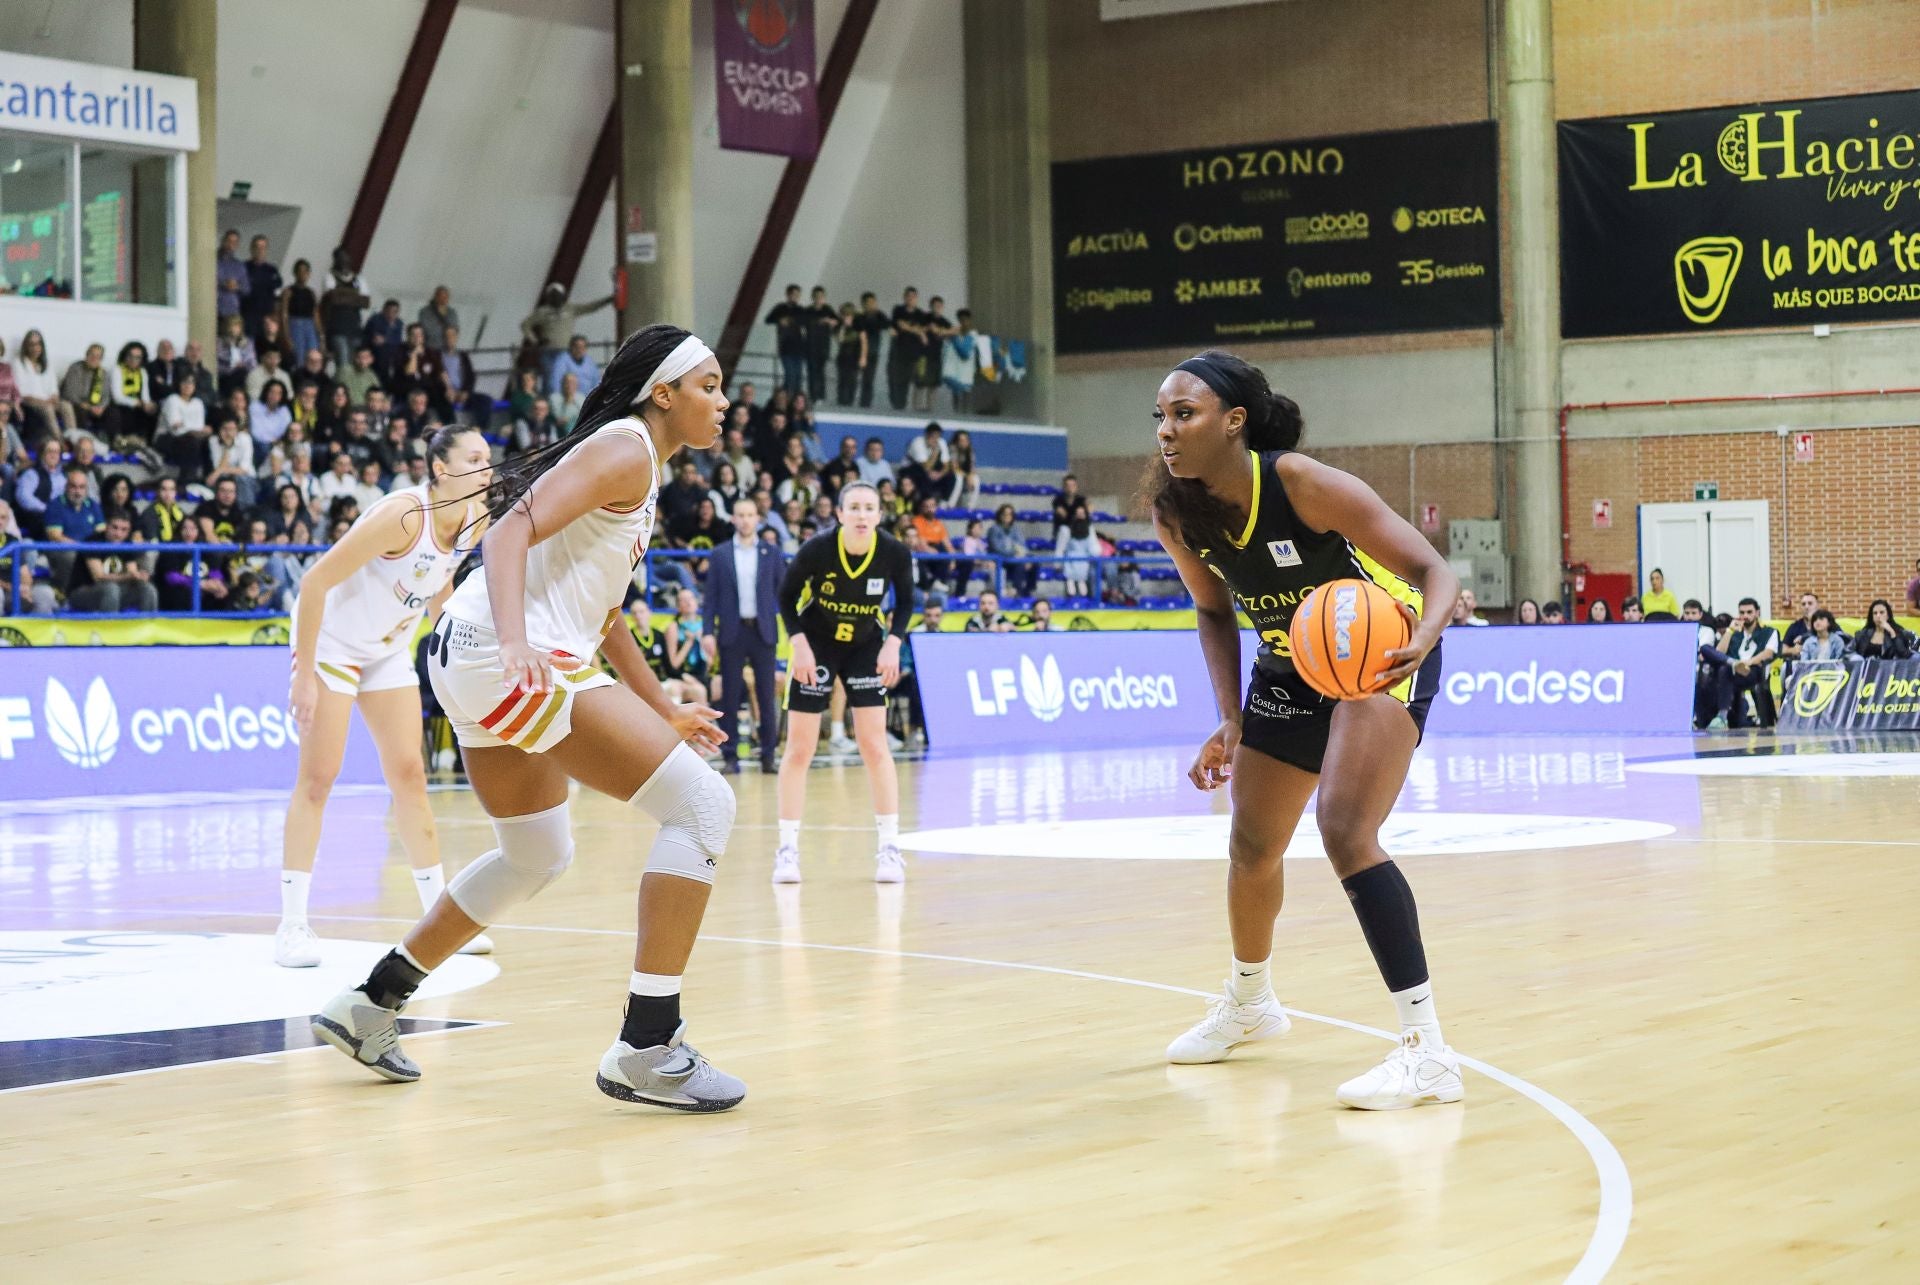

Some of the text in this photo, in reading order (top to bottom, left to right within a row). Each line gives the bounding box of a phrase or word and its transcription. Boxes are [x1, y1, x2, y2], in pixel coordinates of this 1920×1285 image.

[0, 80, 178, 135] antarilla
[1626, 109, 1920, 191] La Hacie
[1183, 147, 1344, 189] HOZONO
[1416, 206, 1486, 228] SOTECA
[1762, 238, 1793, 281] la
[1807, 227, 1878, 275] boca
[1197, 279, 1262, 298] AMBEX
[1303, 270, 1373, 289] entorno
[1773, 286, 1813, 309] MÁS
[1814, 288, 1855, 309] QUE
[835, 623, 855, 642] 6
[967, 666, 1178, 716] LF endesa
[1446, 660, 1625, 705] endesa
[1252, 693, 1276, 711] Costa
[1884, 703, 1911, 714] QUE
